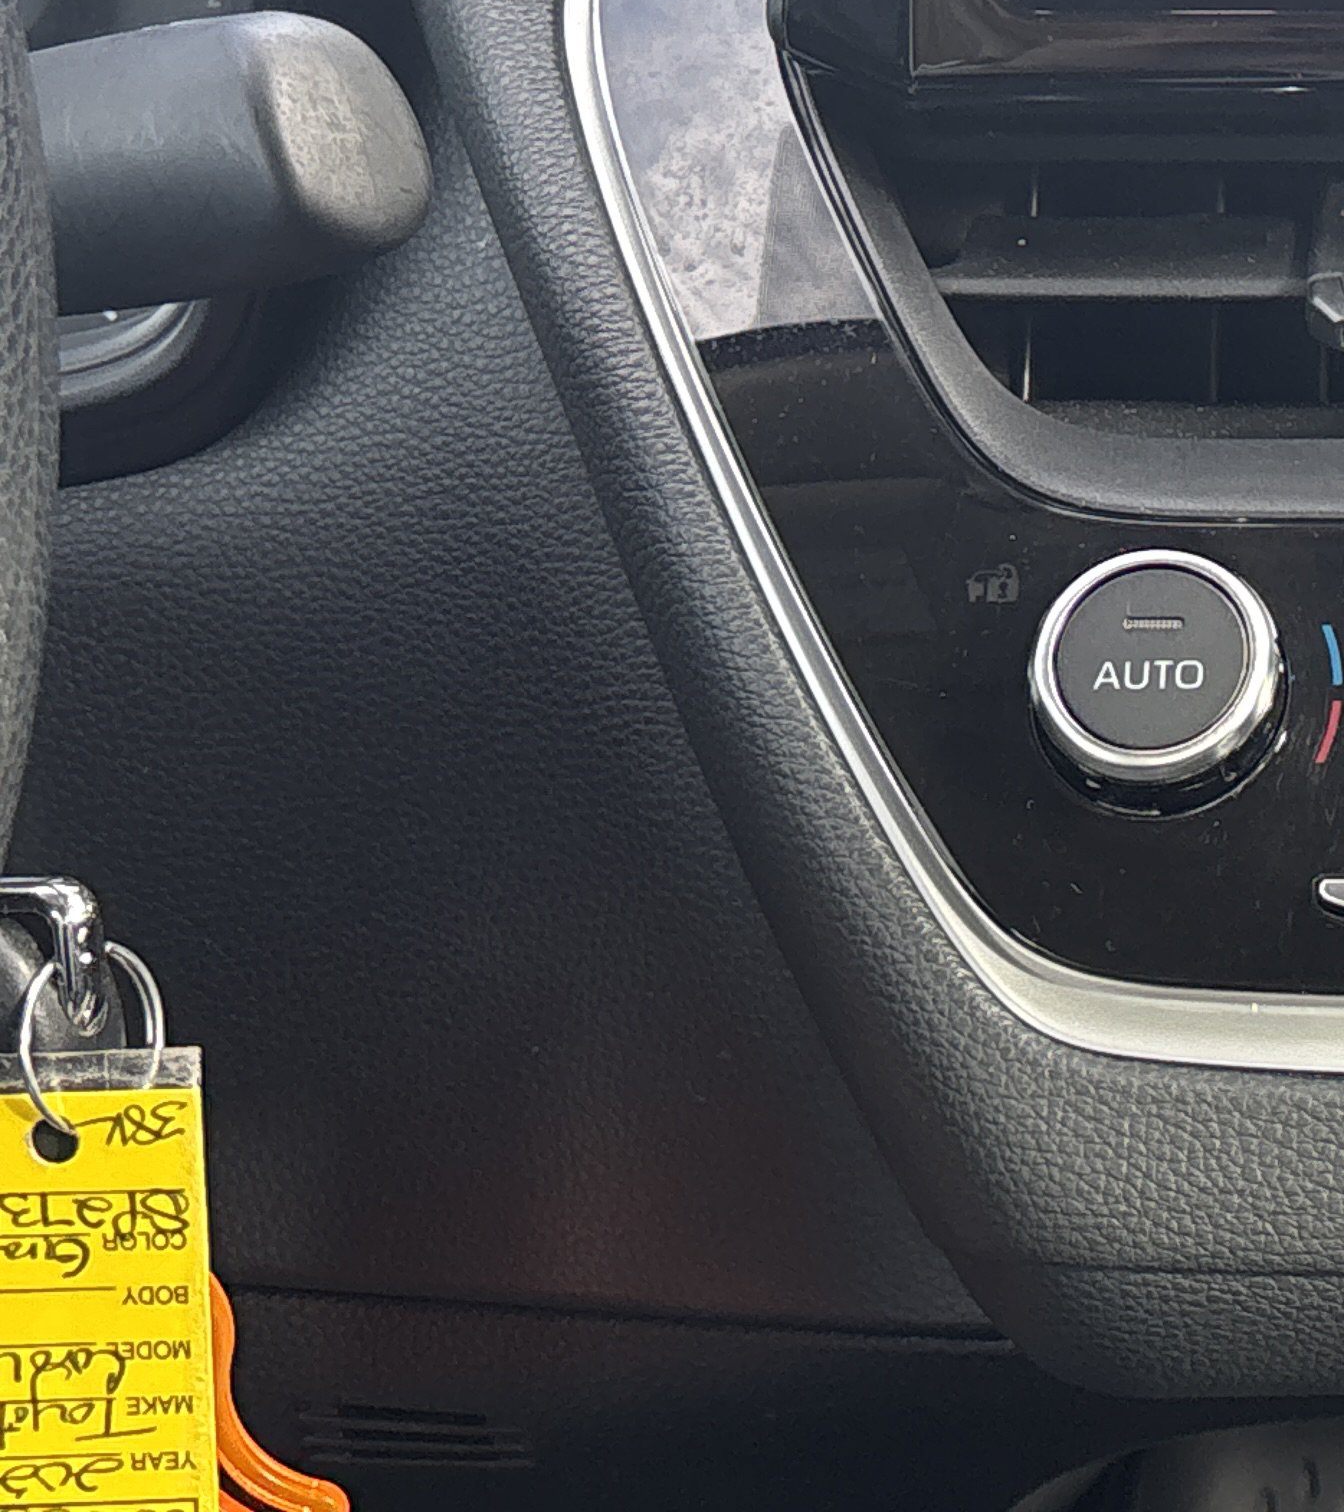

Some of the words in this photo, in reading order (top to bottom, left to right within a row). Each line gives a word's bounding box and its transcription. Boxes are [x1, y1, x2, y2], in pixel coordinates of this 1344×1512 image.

[1092, 659, 1205, 690] AUTO
[102, 1231, 188, 1252] COLOR
[0, 1235, 91, 1278] Gra
[122, 1285, 190, 1305] BODY
[105, 1341, 192, 1360] MODEL
[126, 1396, 194, 1416] MAKE
[130, 1451, 197, 1471] YEAR
